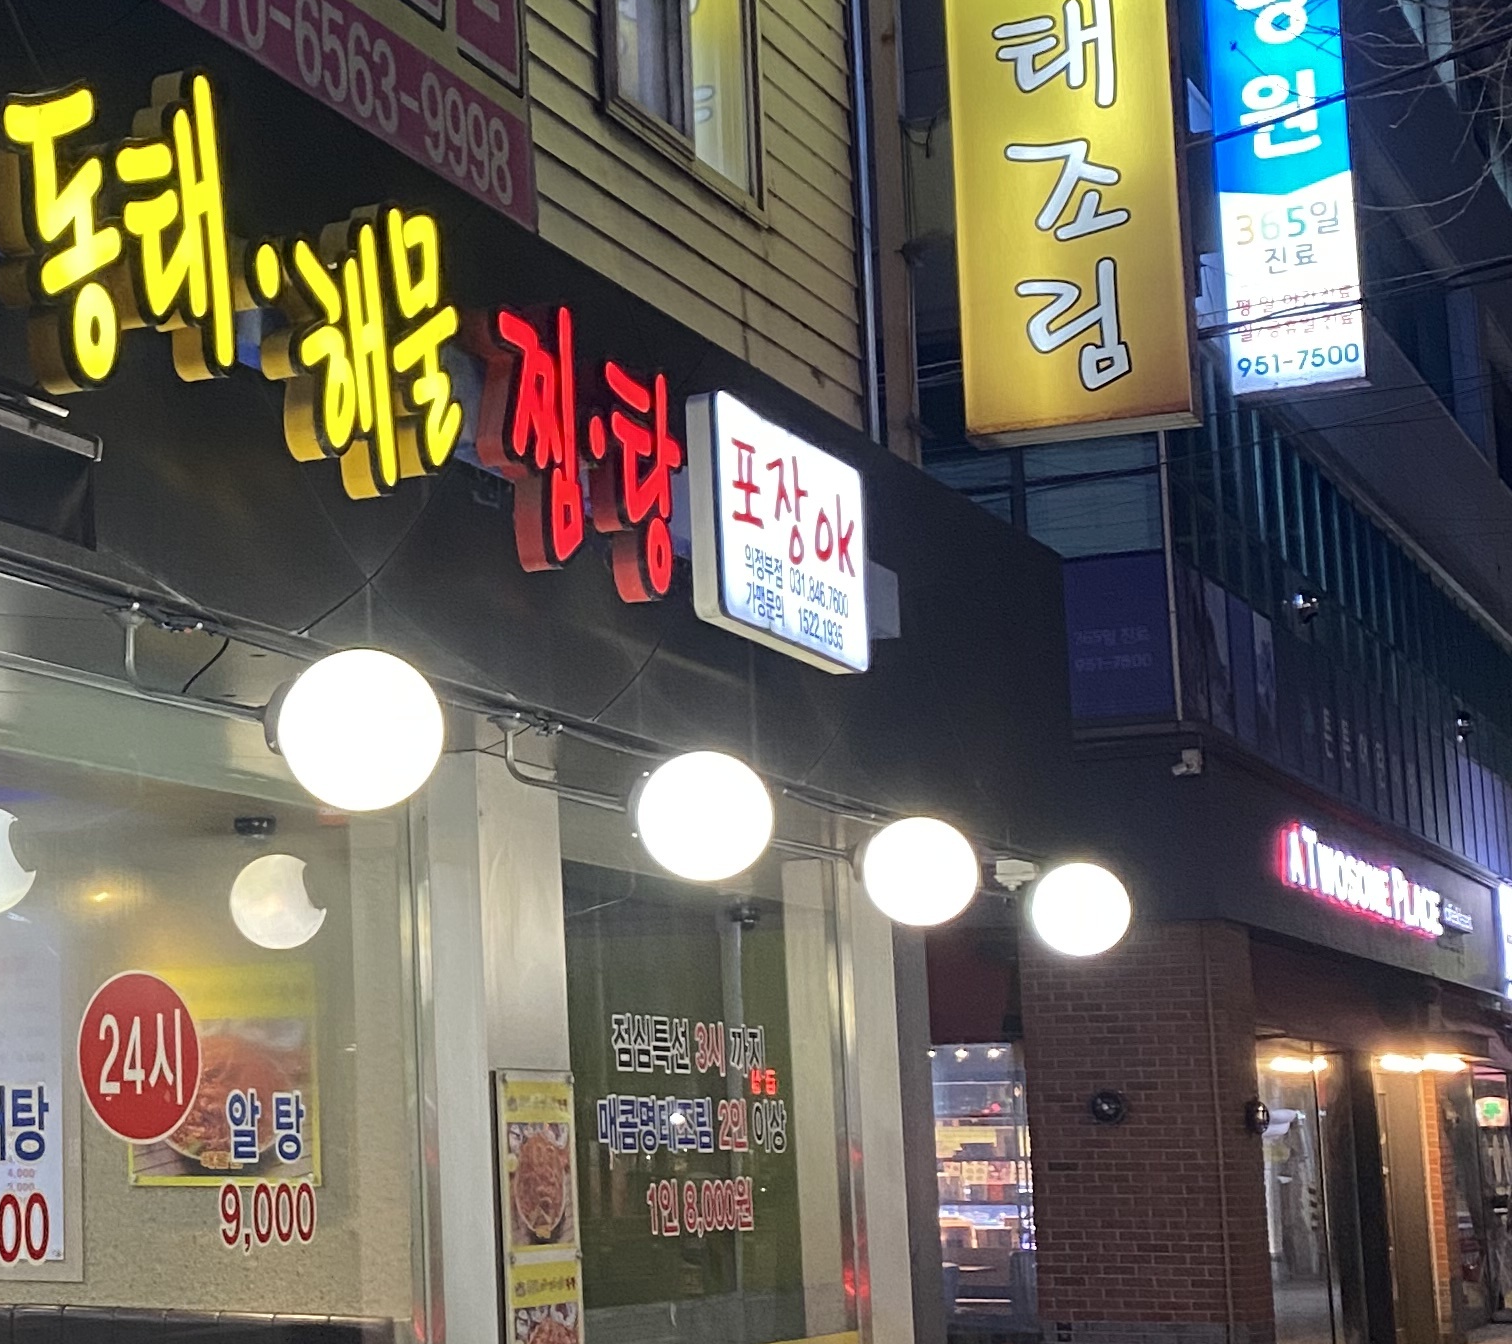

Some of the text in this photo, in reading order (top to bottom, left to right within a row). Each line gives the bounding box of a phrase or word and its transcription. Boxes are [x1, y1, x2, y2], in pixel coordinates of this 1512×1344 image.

[1236, 200, 1341, 246] 365일
[1264, 243, 1318, 275] 진료
[1237, 343, 1360, 378] 951-7500
[744, 543, 784, 590] 의정부점
[745, 581, 786, 628] 가맹문의
[98, 1007, 184, 1106] 24시
[611, 1012, 766, 1078] 점심특선 3시 까지
[717, 1097, 749, 1152] 2인
[752, 1097, 788, 1154] 이상
[219, 1183, 317, 1253] 9,000
[646, 1175, 755, 1239] 1인 8,000원
